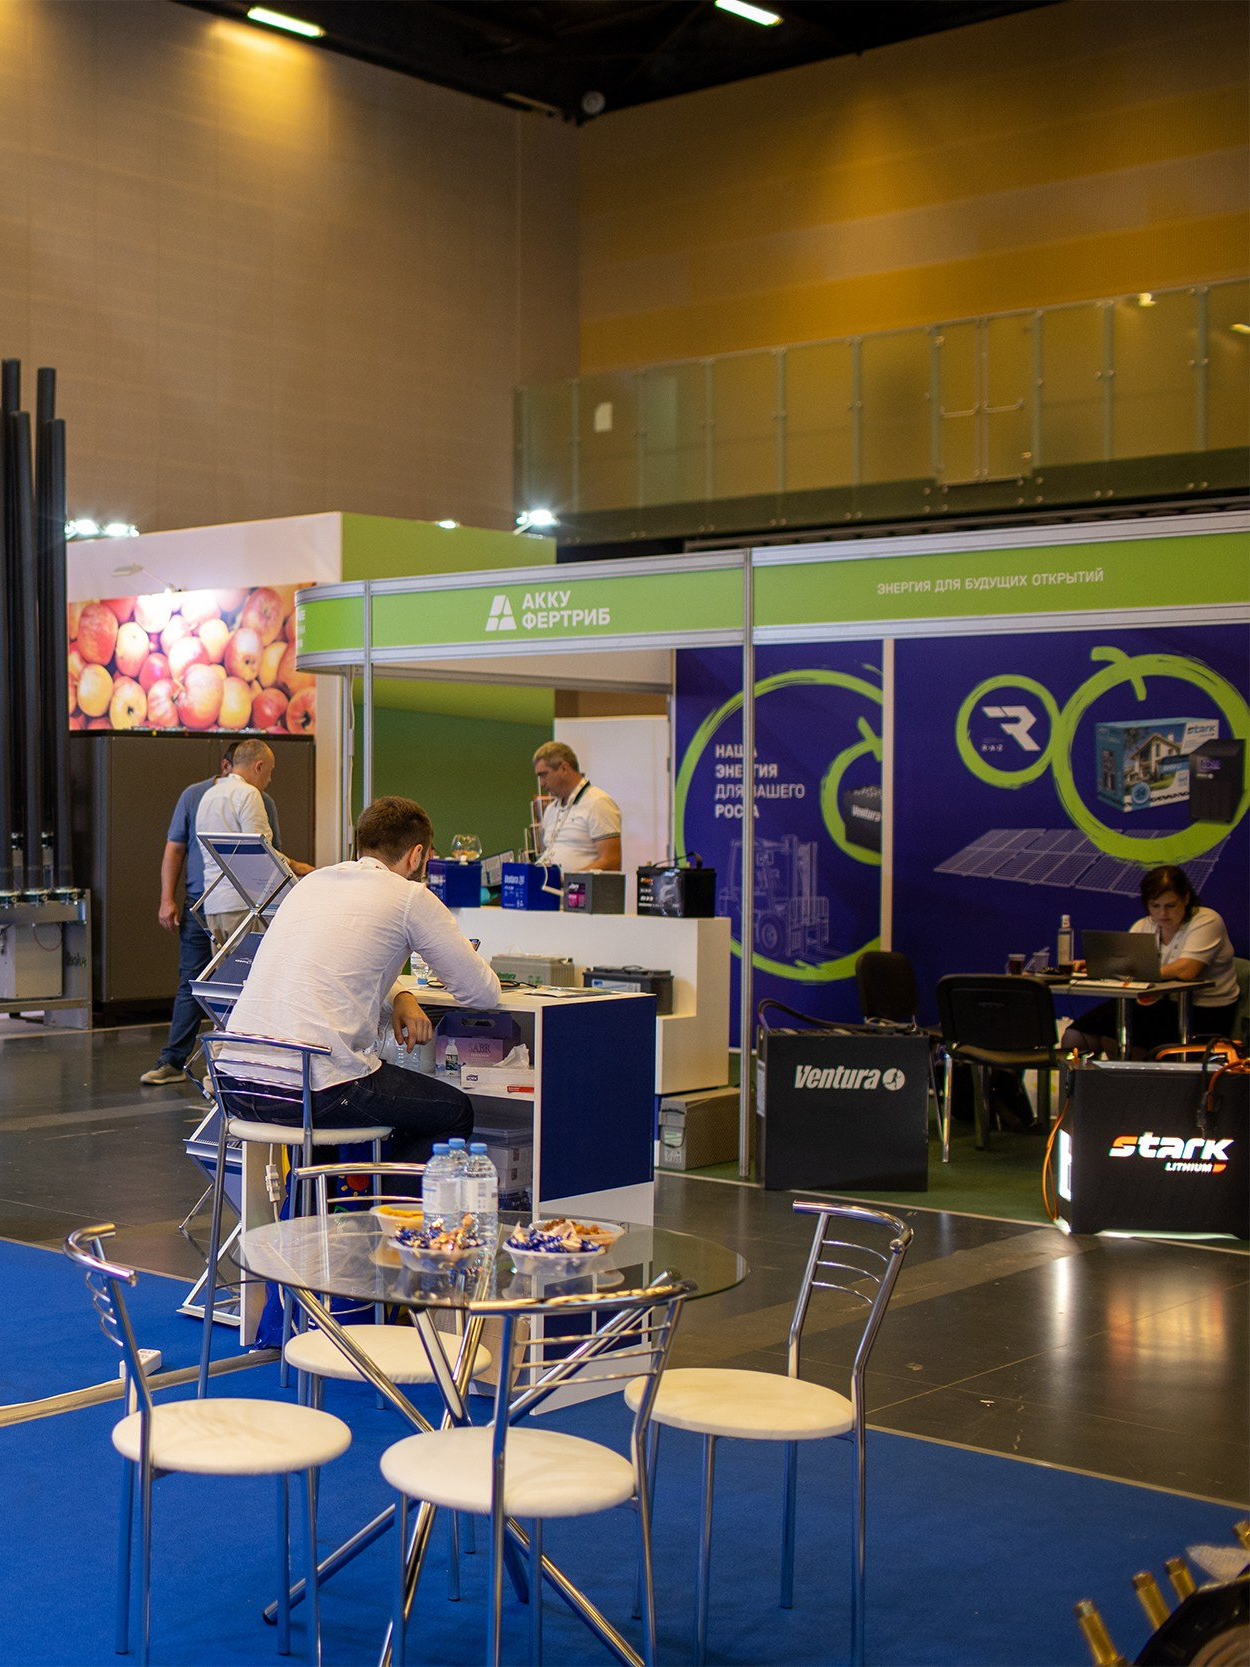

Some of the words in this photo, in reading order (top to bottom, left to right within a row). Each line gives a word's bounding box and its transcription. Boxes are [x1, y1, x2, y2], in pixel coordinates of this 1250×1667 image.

[877, 580, 931, 595] ЭНЕРГИЯ
[934, 578, 961, 593] ДЛЯ
[965, 575, 1028, 590] БУДУЩИХ
[1032, 567, 1104, 586] ОТКРЫТИЙ
[522, 590, 571, 610] АККУ
[522, 608, 611, 630] ФЕРТРИБ
[715, 763, 778, 778] ЭНЕГИЯ
[794, 1064, 882, 1090] Ventura
[1108, 1131, 1235, 1160] stark
[1164, 1162, 1214, 1174] LITHIUM
